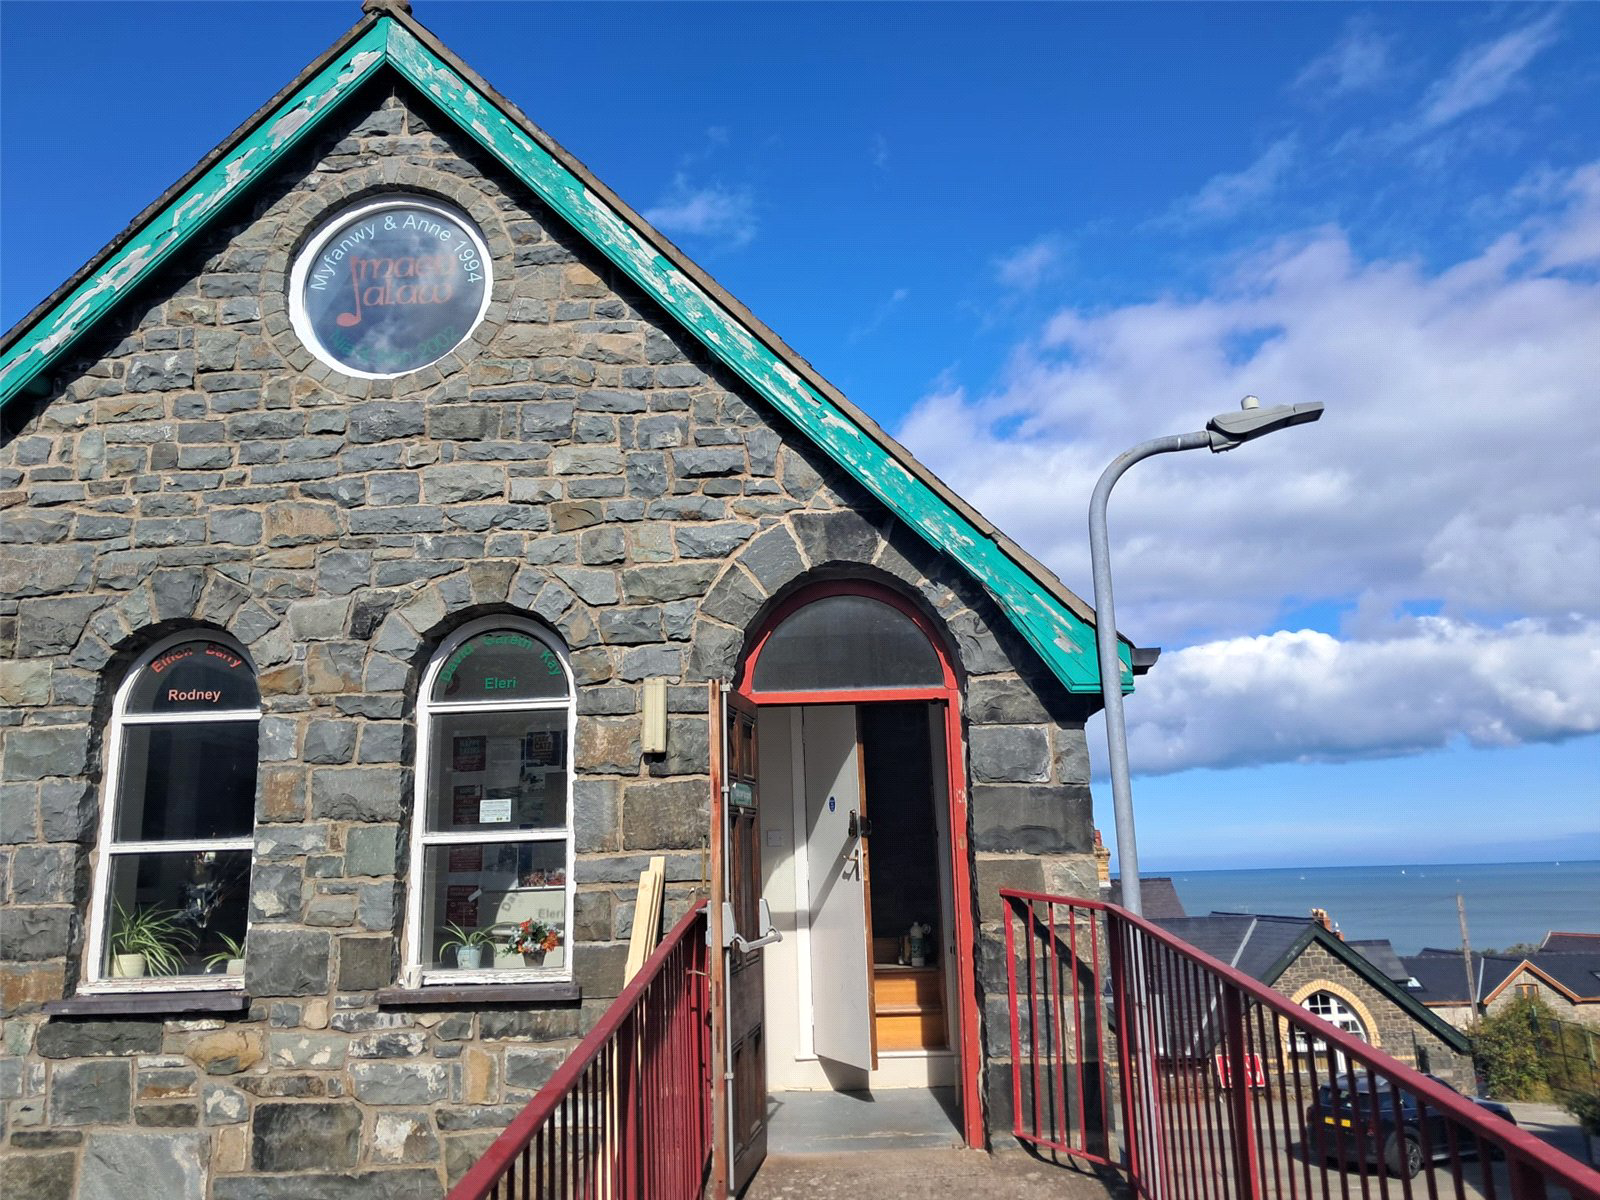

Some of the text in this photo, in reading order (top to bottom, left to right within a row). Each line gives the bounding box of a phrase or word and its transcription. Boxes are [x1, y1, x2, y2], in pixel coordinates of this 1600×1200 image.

[310, 214, 483, 291] Myfanwy & Anne 1994
[540, 649, 561, 677] Kay
[484, 677, 517, 690] Eleri
[168, 688, 221, 702] Rodney
